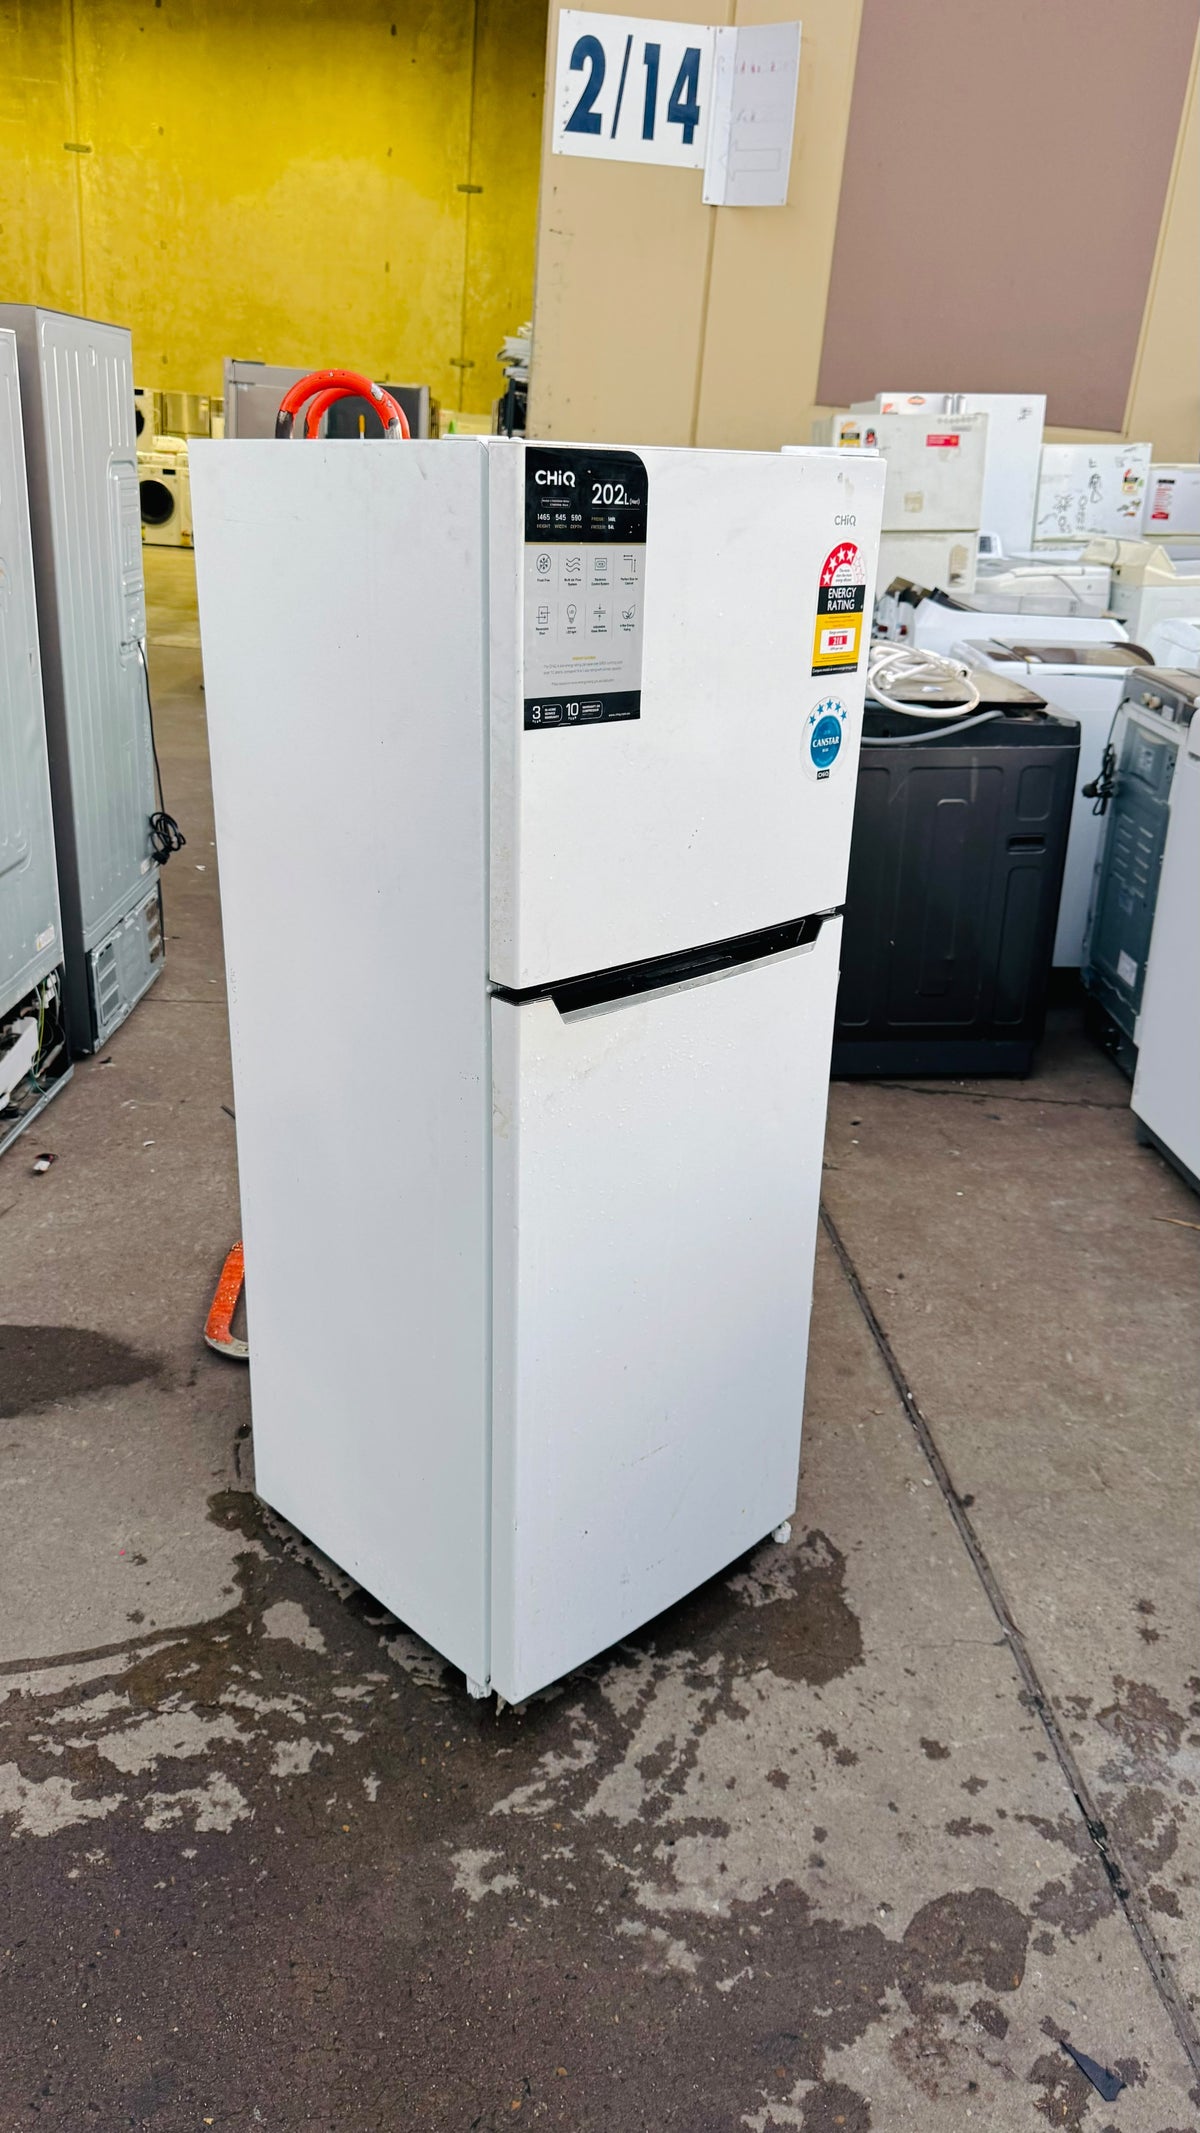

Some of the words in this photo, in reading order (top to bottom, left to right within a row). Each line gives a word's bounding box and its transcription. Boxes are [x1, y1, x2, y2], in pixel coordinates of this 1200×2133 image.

[563, 34, 701, 145] 2/14
[535, 470, 575, 487] CHiQ
[537, 513, 551, 521] 1465
[555, 513, 567, 521] 545
[834, 514, 857, 527] CHiQ
[828, 587, 856, 600] ENERGY
[827, 599, 855, 612] RATING
[532, 706, 541, 719] 3
[565, 702, 579, 717] 10
[812, 737, 839, 747] CANSTAR
